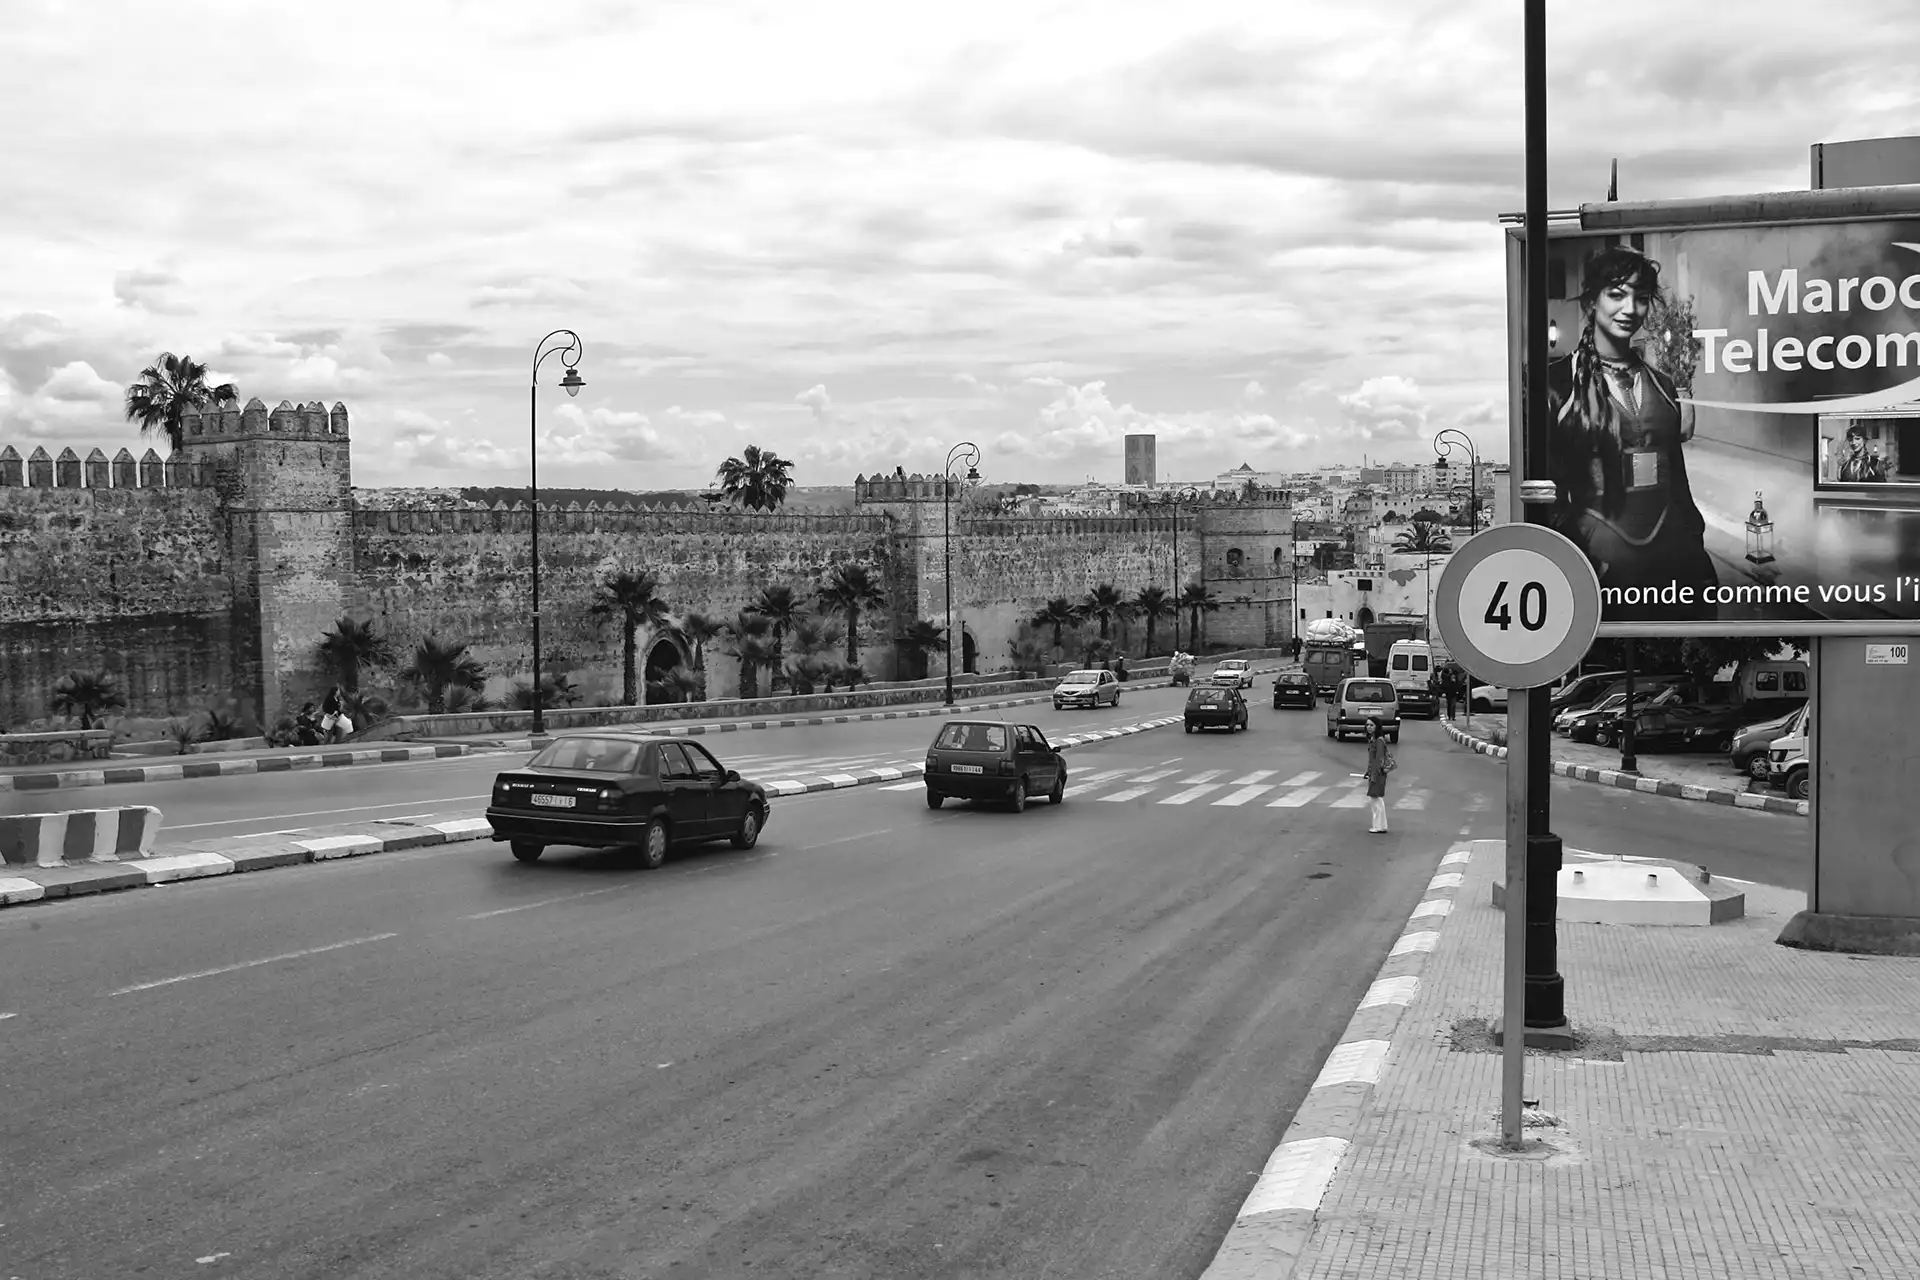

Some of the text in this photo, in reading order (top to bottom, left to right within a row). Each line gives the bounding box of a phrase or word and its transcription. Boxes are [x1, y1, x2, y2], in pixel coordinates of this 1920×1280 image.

[1747, 268, 1920, 316] Maroc
[1692, 328, 1920, 374] Telecom
[1484, 581, 1547, 631] 40
[1600, 579, 1695, 605] monde
[1702, 583, 1810, 604] comme
[1818, 583, 1886, 603] vous
[1890, 646, 1906, 658] 100
